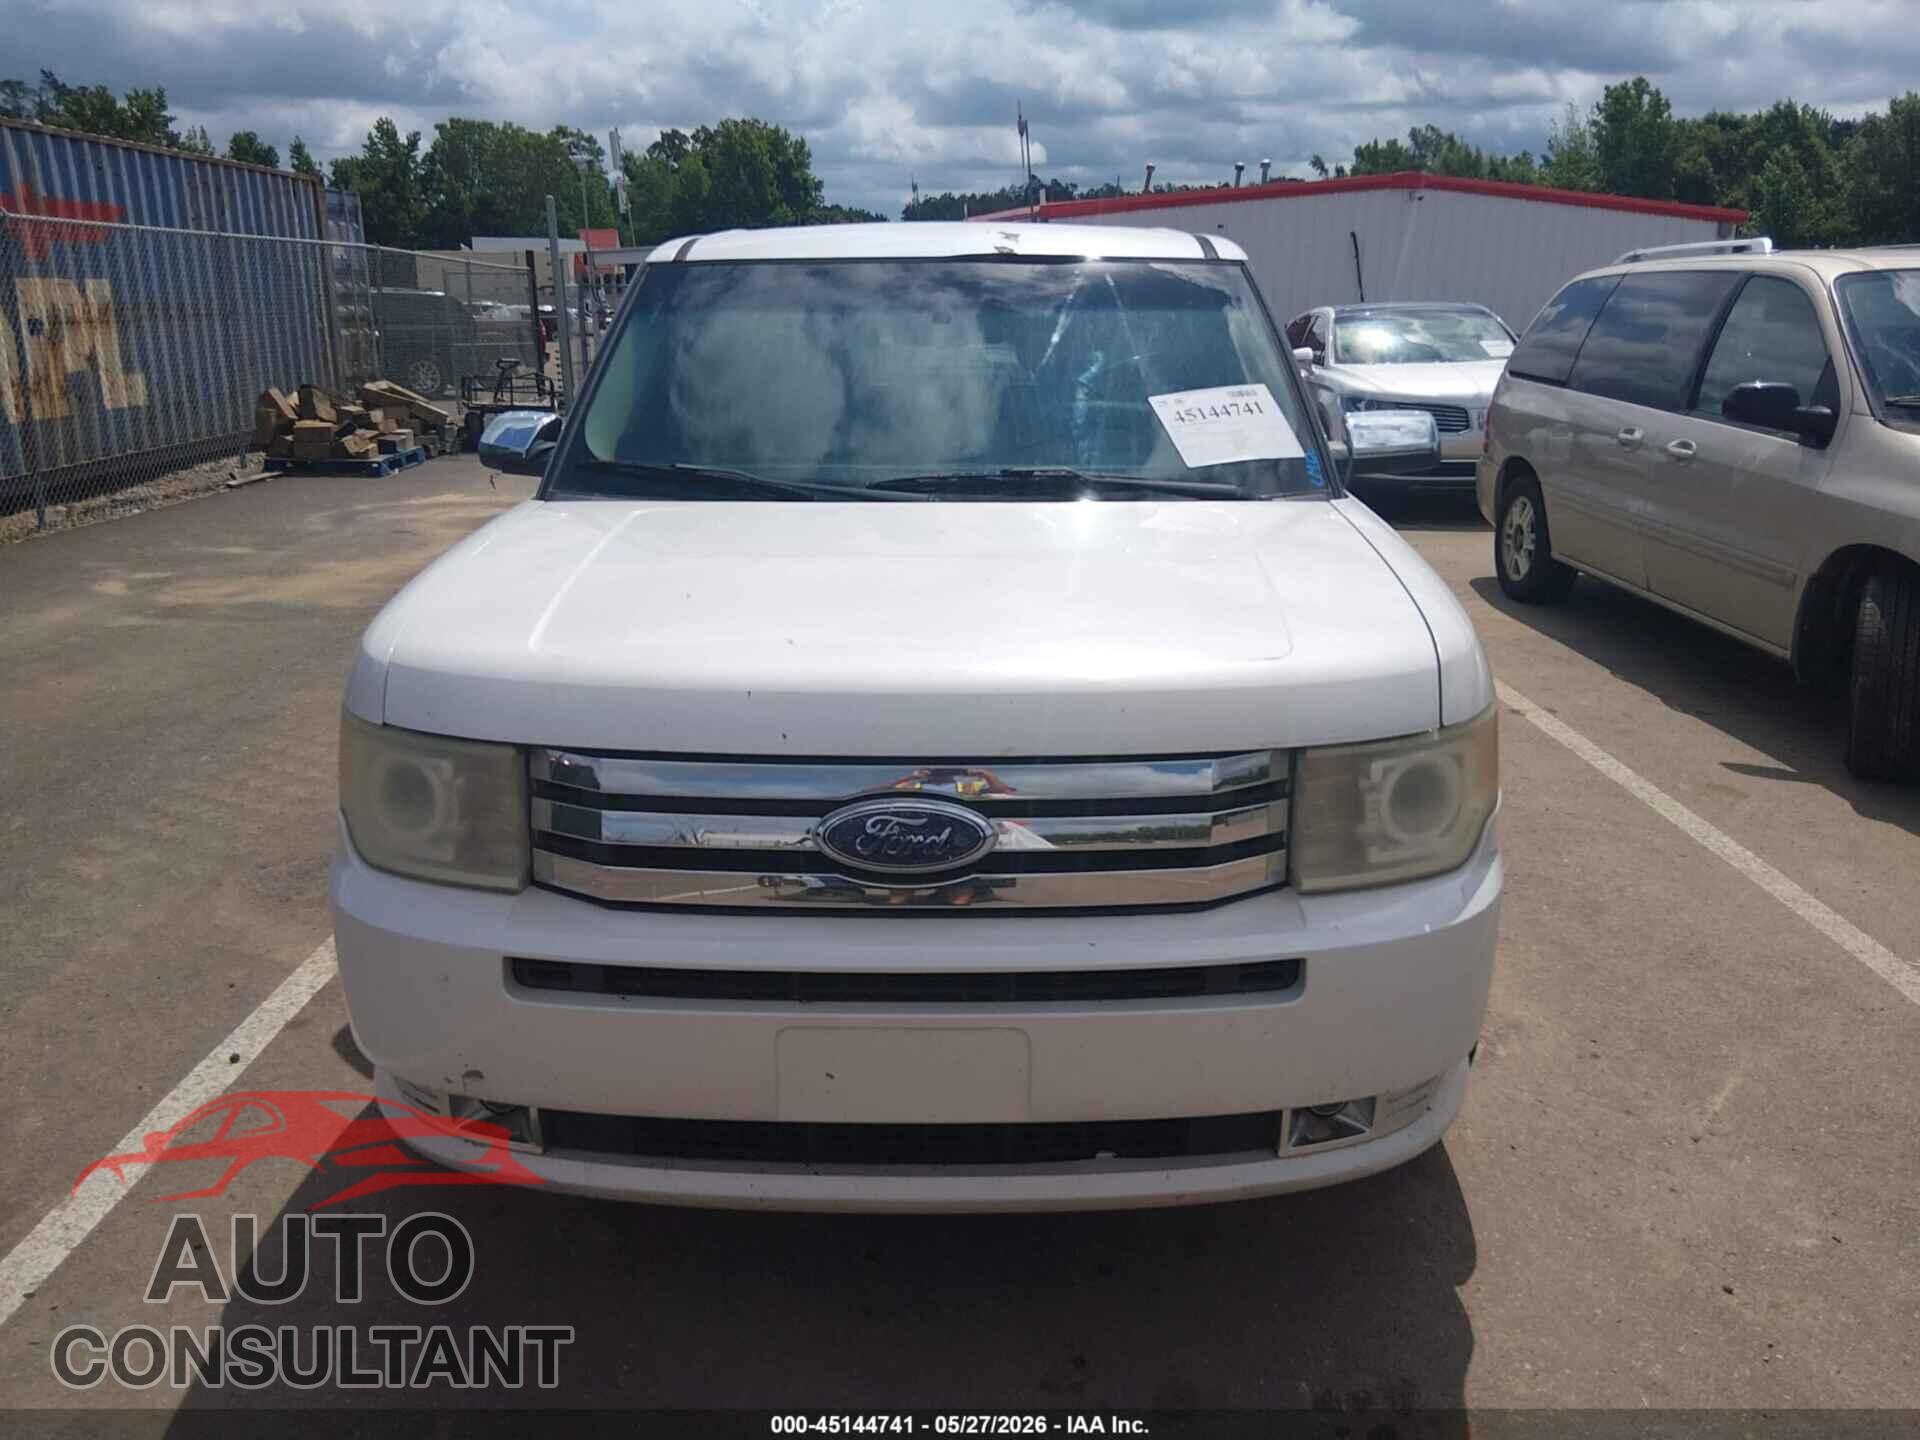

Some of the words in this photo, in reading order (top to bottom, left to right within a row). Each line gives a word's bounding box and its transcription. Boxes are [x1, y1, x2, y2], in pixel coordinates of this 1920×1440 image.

[0, 277, 149, 425] PL
[1174, 401, 1265, 424] 45144741
[855, 815, 953, 856] Ford
